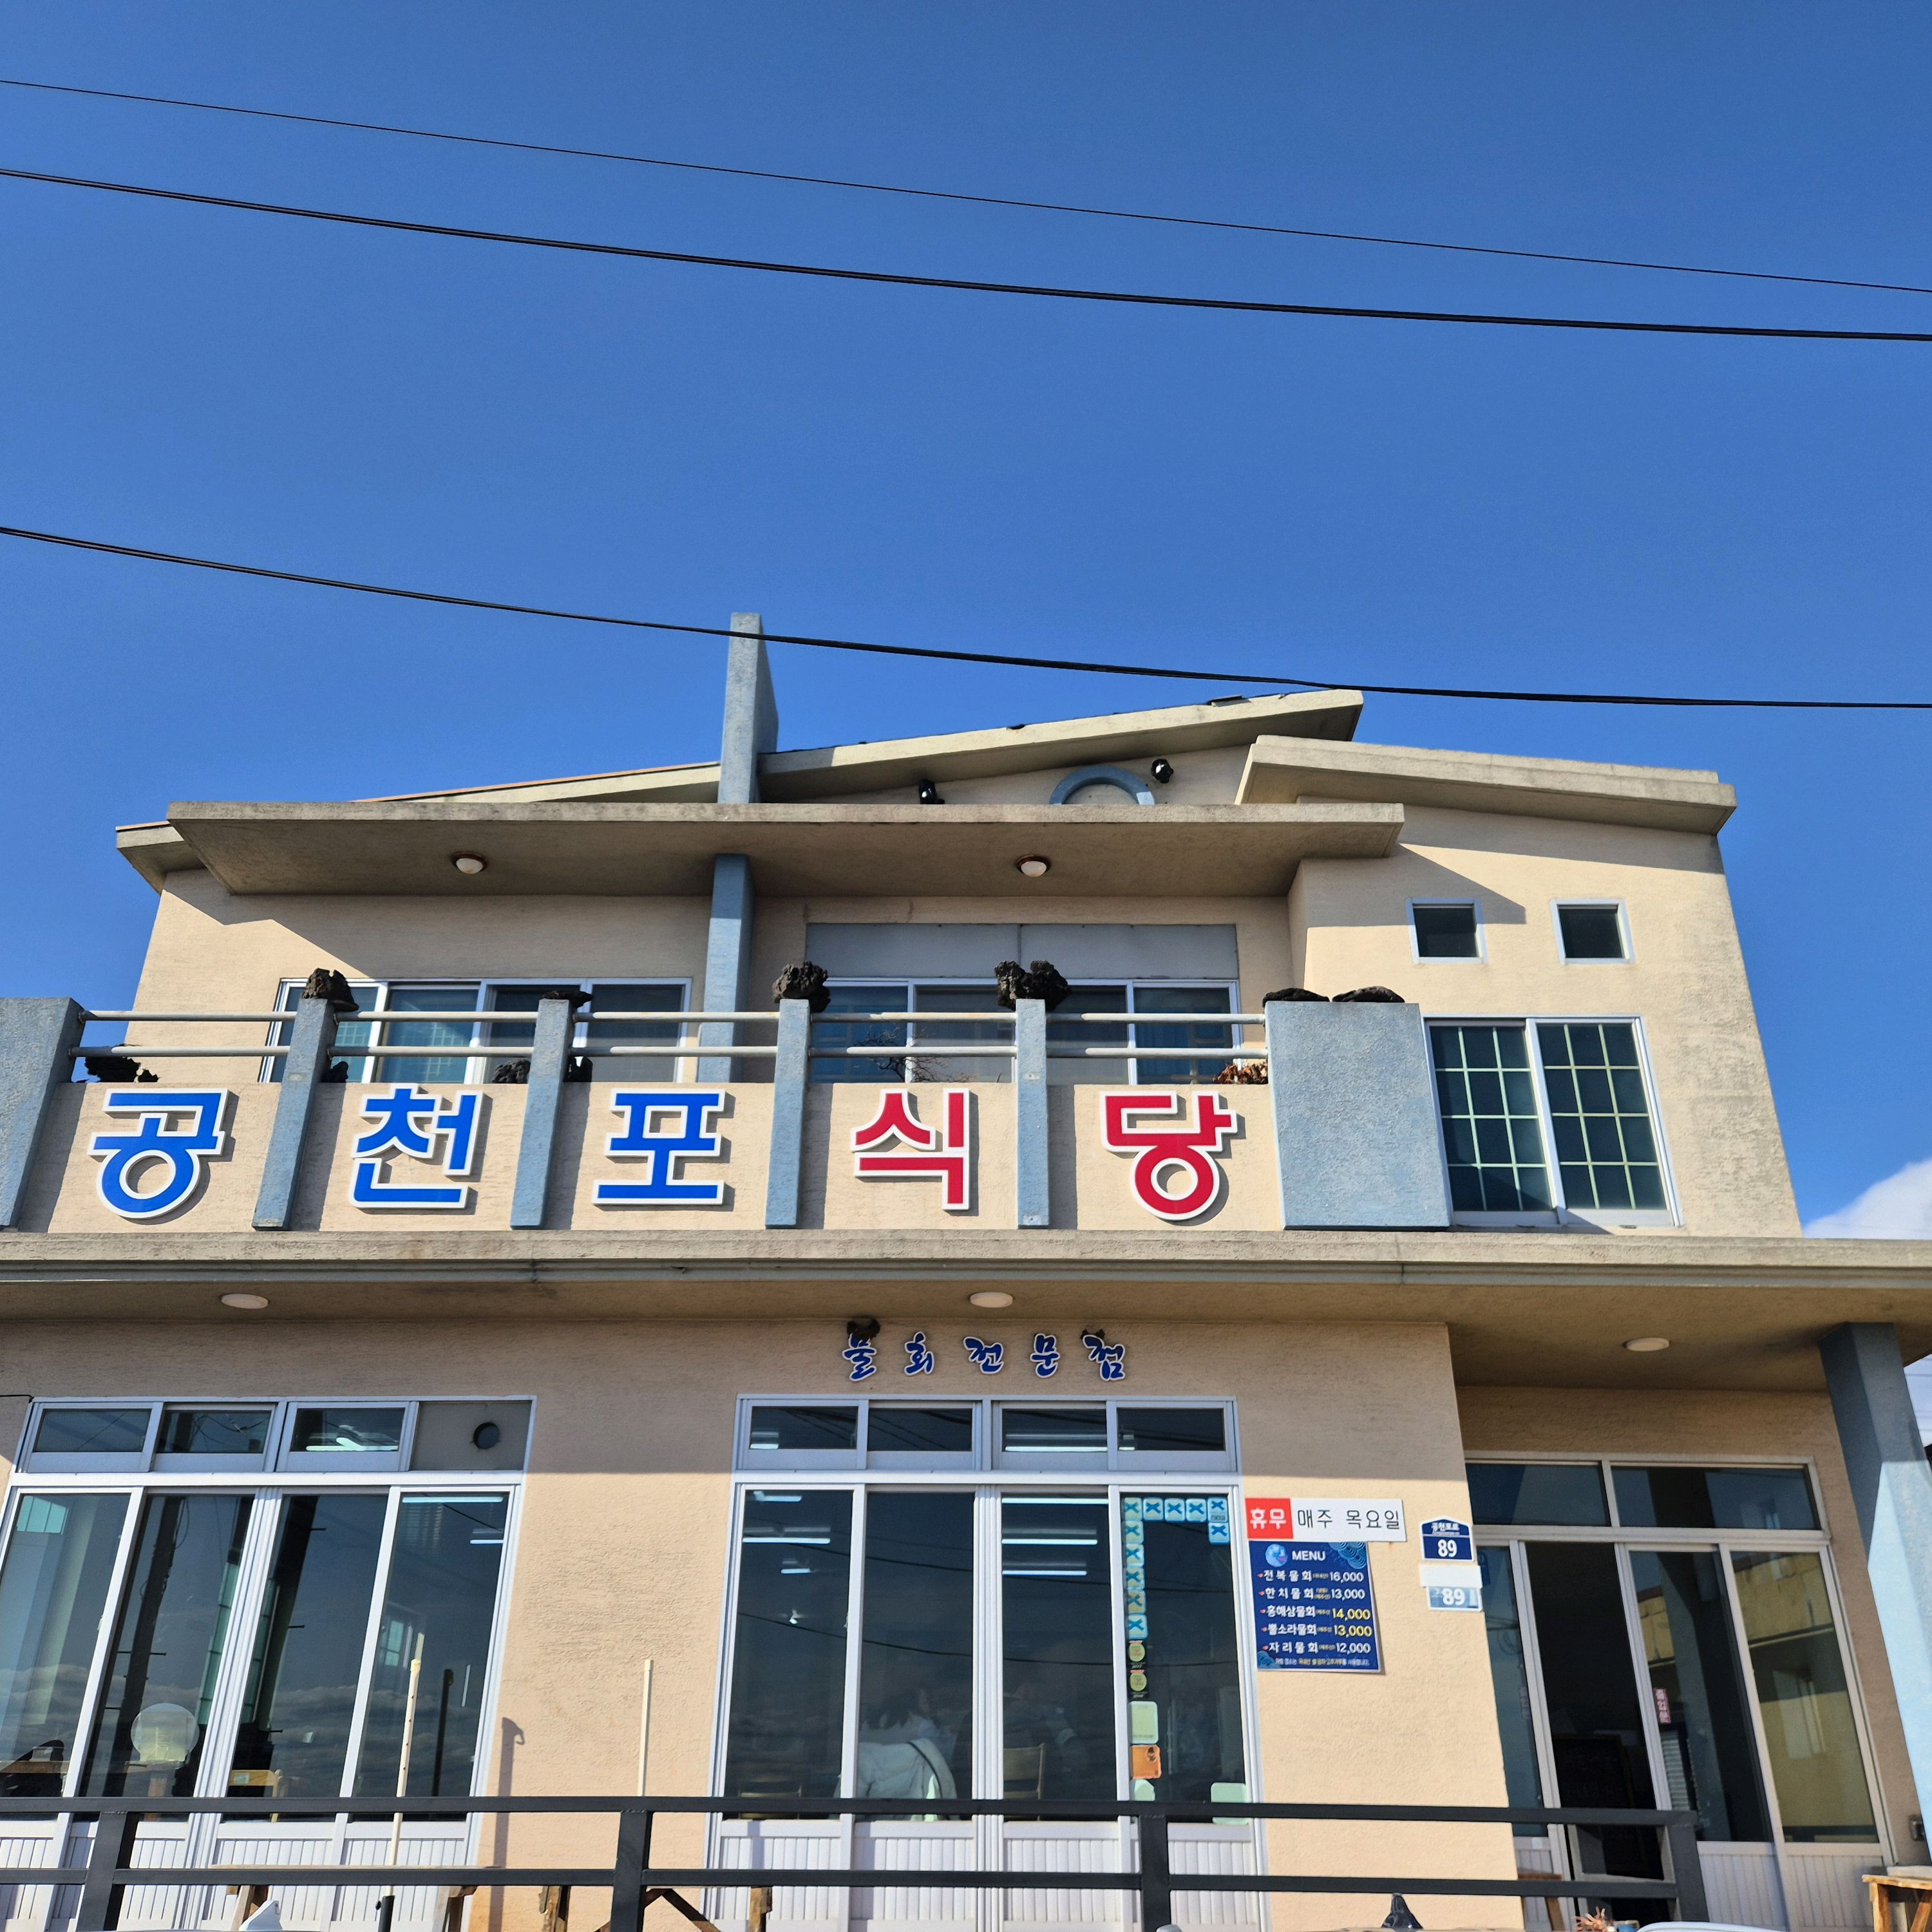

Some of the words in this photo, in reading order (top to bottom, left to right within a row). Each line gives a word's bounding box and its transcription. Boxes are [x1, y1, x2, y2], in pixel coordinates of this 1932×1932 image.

[1250, 1508, 1287, 1530] 휴무
[1298, 1510, 1333, 1528] 매주
[1346, 1510, 1401, 1530] 목요일
[1437, 1539, 1457, 1557] 89
[1292, 1551, 1326, 1561] MENU
[1330, 1571, 1364, 1583] 16,000
[1331, 1589, 1365, 1601] 13,000
[1442, 1588, 1466, 1605] 89
[1332, 1608, 1371, 1621] 14,000
[1334, 1625, 1372, 1638] 13,000
[1336, 1643, 1371, 1655] 12,000
